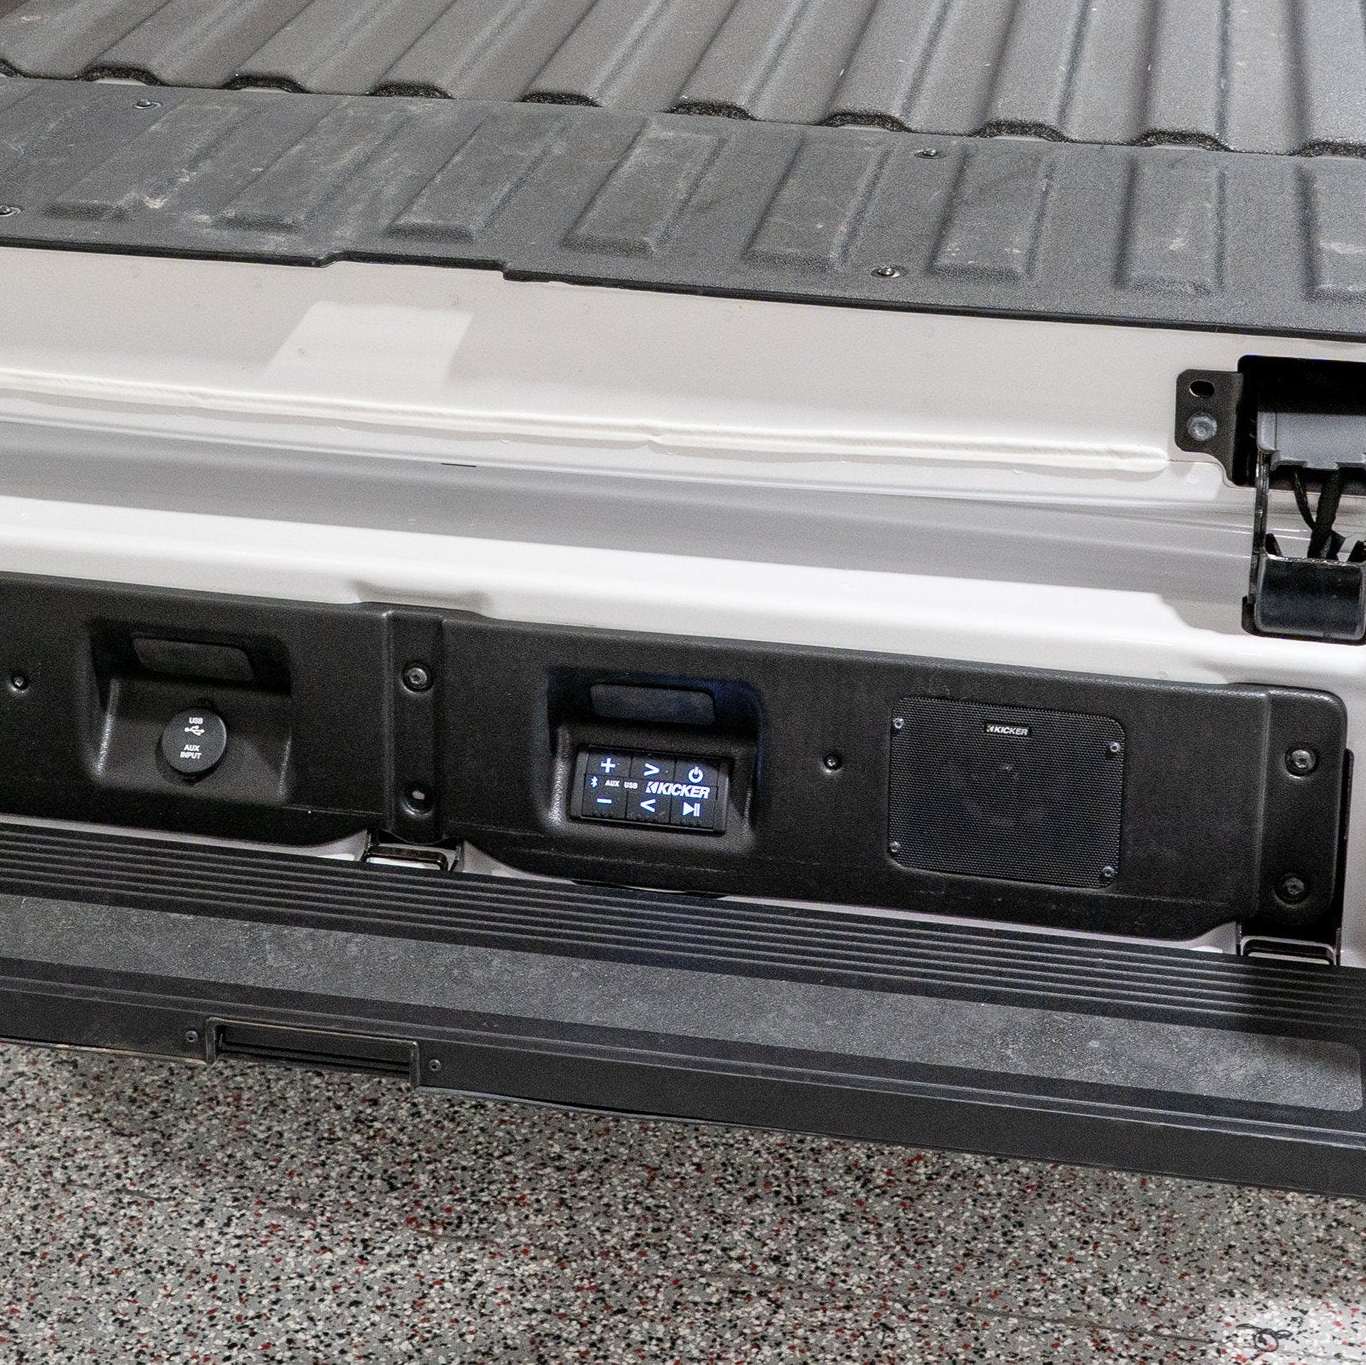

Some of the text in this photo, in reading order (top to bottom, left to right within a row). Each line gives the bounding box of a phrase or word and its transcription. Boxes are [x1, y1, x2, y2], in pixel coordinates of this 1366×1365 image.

[994, 726, 1028, 736] KICKER
[183, 744, 200, 752] AUX
[180, 751, 202, 759] INPUT
[605, 779, 638, 790] AUX USB
[656, 781, 711, 799] KICKER
